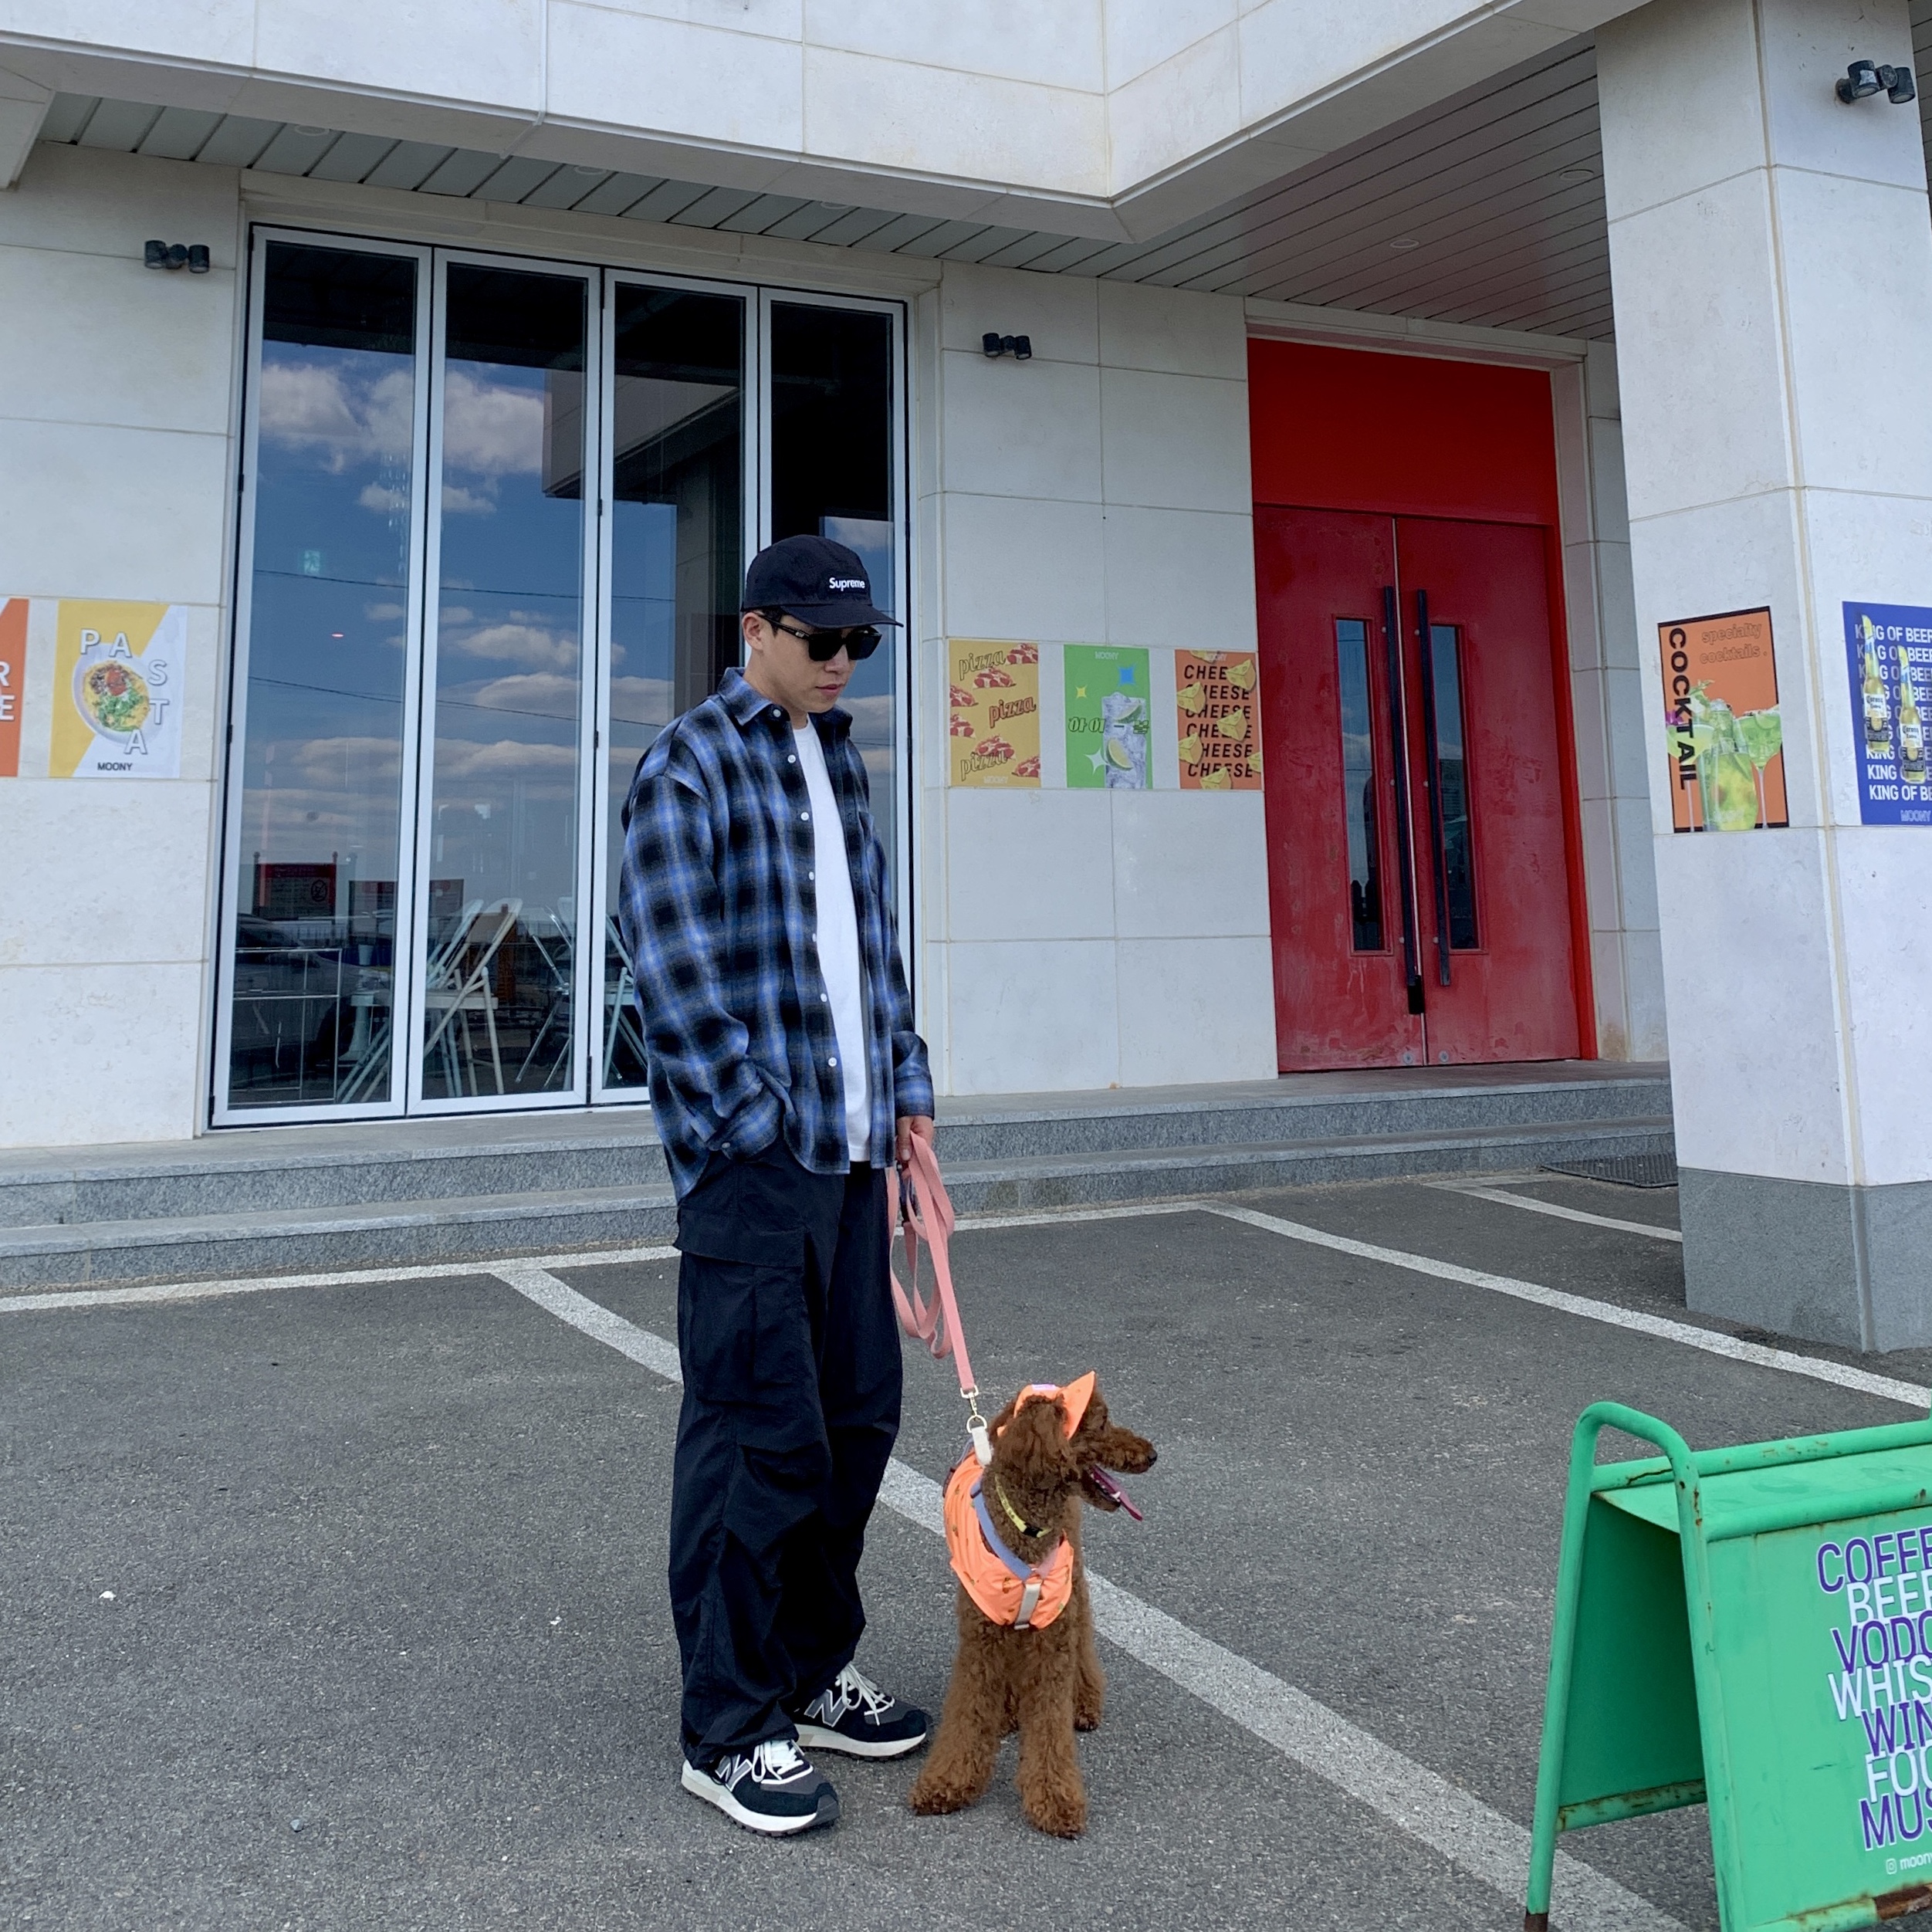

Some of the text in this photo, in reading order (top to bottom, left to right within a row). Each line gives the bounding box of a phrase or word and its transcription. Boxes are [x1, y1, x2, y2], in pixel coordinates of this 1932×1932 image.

[829, 577, 865, 592] Supreme
[1701, 623, 1761, 645] specialty
[1886, 625, 1903, 641] OF
[1699, 644, 1761, 665] cocktails
[959, 650, 1007, 682] pizza
[1184, 665, 1228, 680] CHEE
[988, 696, 1037, 729] pizza
[1669, 628, 1697, 790] COCKTAIL
[97, 761, 134, 772] MOONY
[960, 749, 1009, 781] pizza
[1867, 764, 1897, 781] KING
[1869, 784, 1900, 801] KING
[1901, 785, 1917, 801] OF
[1900, 1852, 1932, 1871] moon
